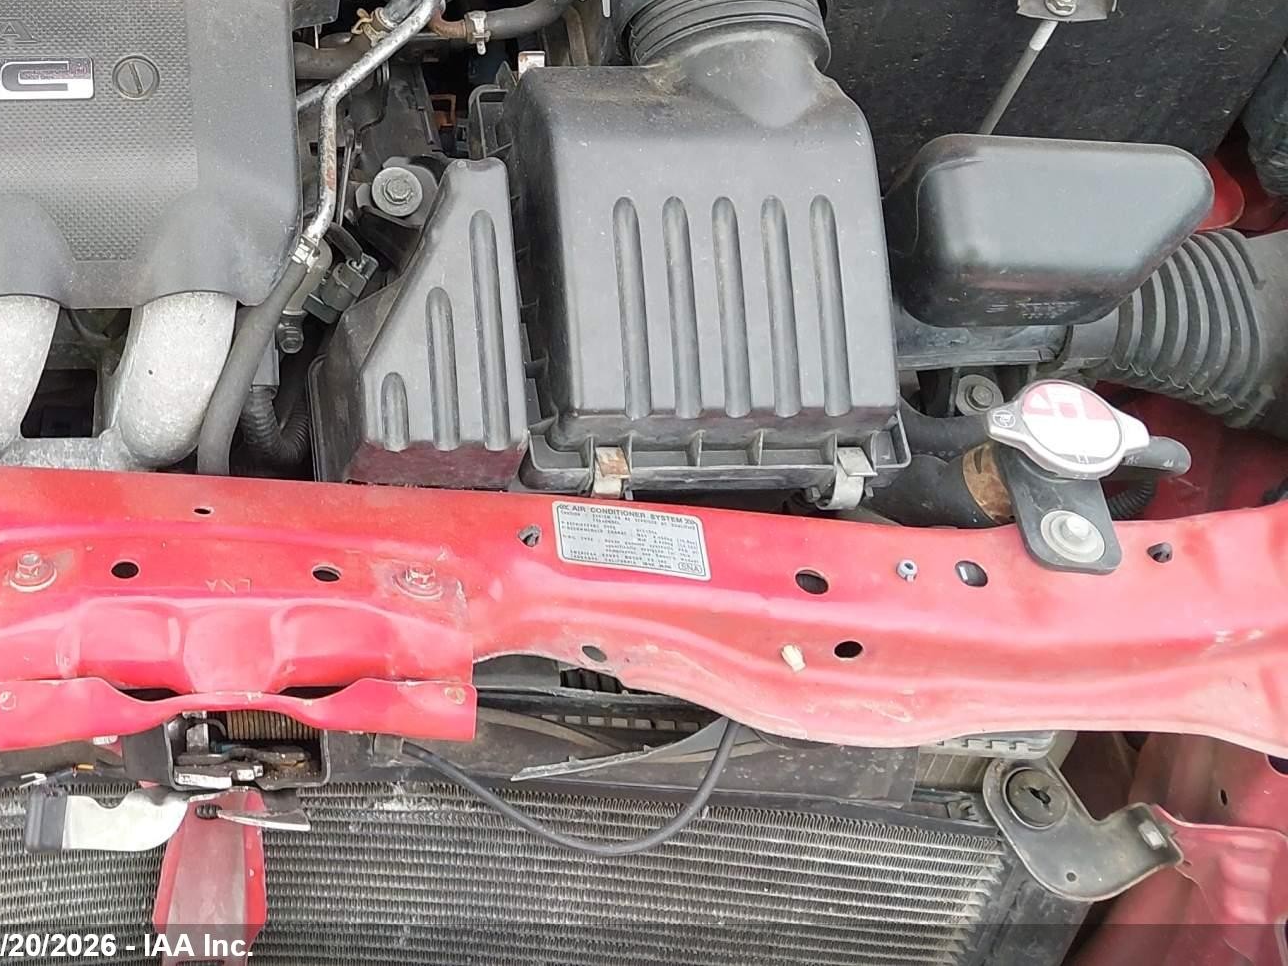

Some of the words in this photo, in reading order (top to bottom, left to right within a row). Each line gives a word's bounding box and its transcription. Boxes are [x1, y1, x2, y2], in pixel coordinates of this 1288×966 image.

[572, 505, 586, 513] AIR
[590, 506, 646, 518] CONDITIONER
[650, 513, 683, 523] SYSTEM
